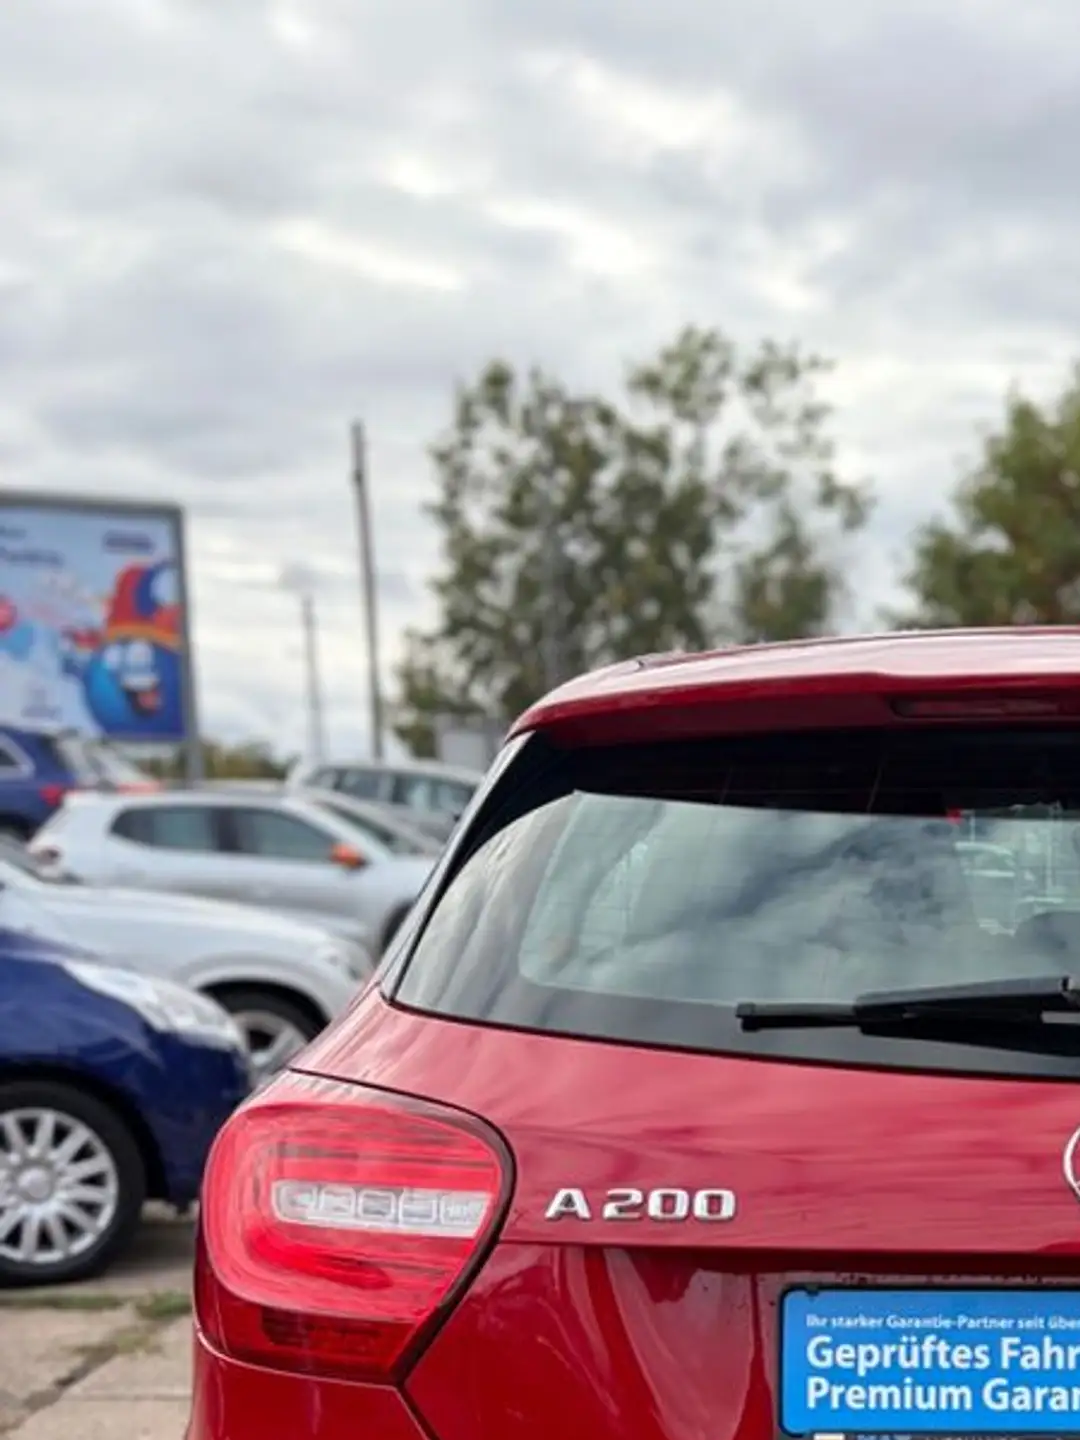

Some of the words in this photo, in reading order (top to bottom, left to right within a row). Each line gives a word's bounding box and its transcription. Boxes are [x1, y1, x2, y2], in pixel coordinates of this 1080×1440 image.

[544, 1188, 590, 1221] A
[603, 1188, 735, 1222] 200
[806, 1314, 827, 1328] Ihr
[831, 1314, 882, 1328] starker
[886, 1314, 1013, 1330] Garantie-Partner
[1017, 1316, 1044, 1330] seit
[806, 1334, 990, 1377] Geprüftes
[806, 1376, 973, 1410] Premium
